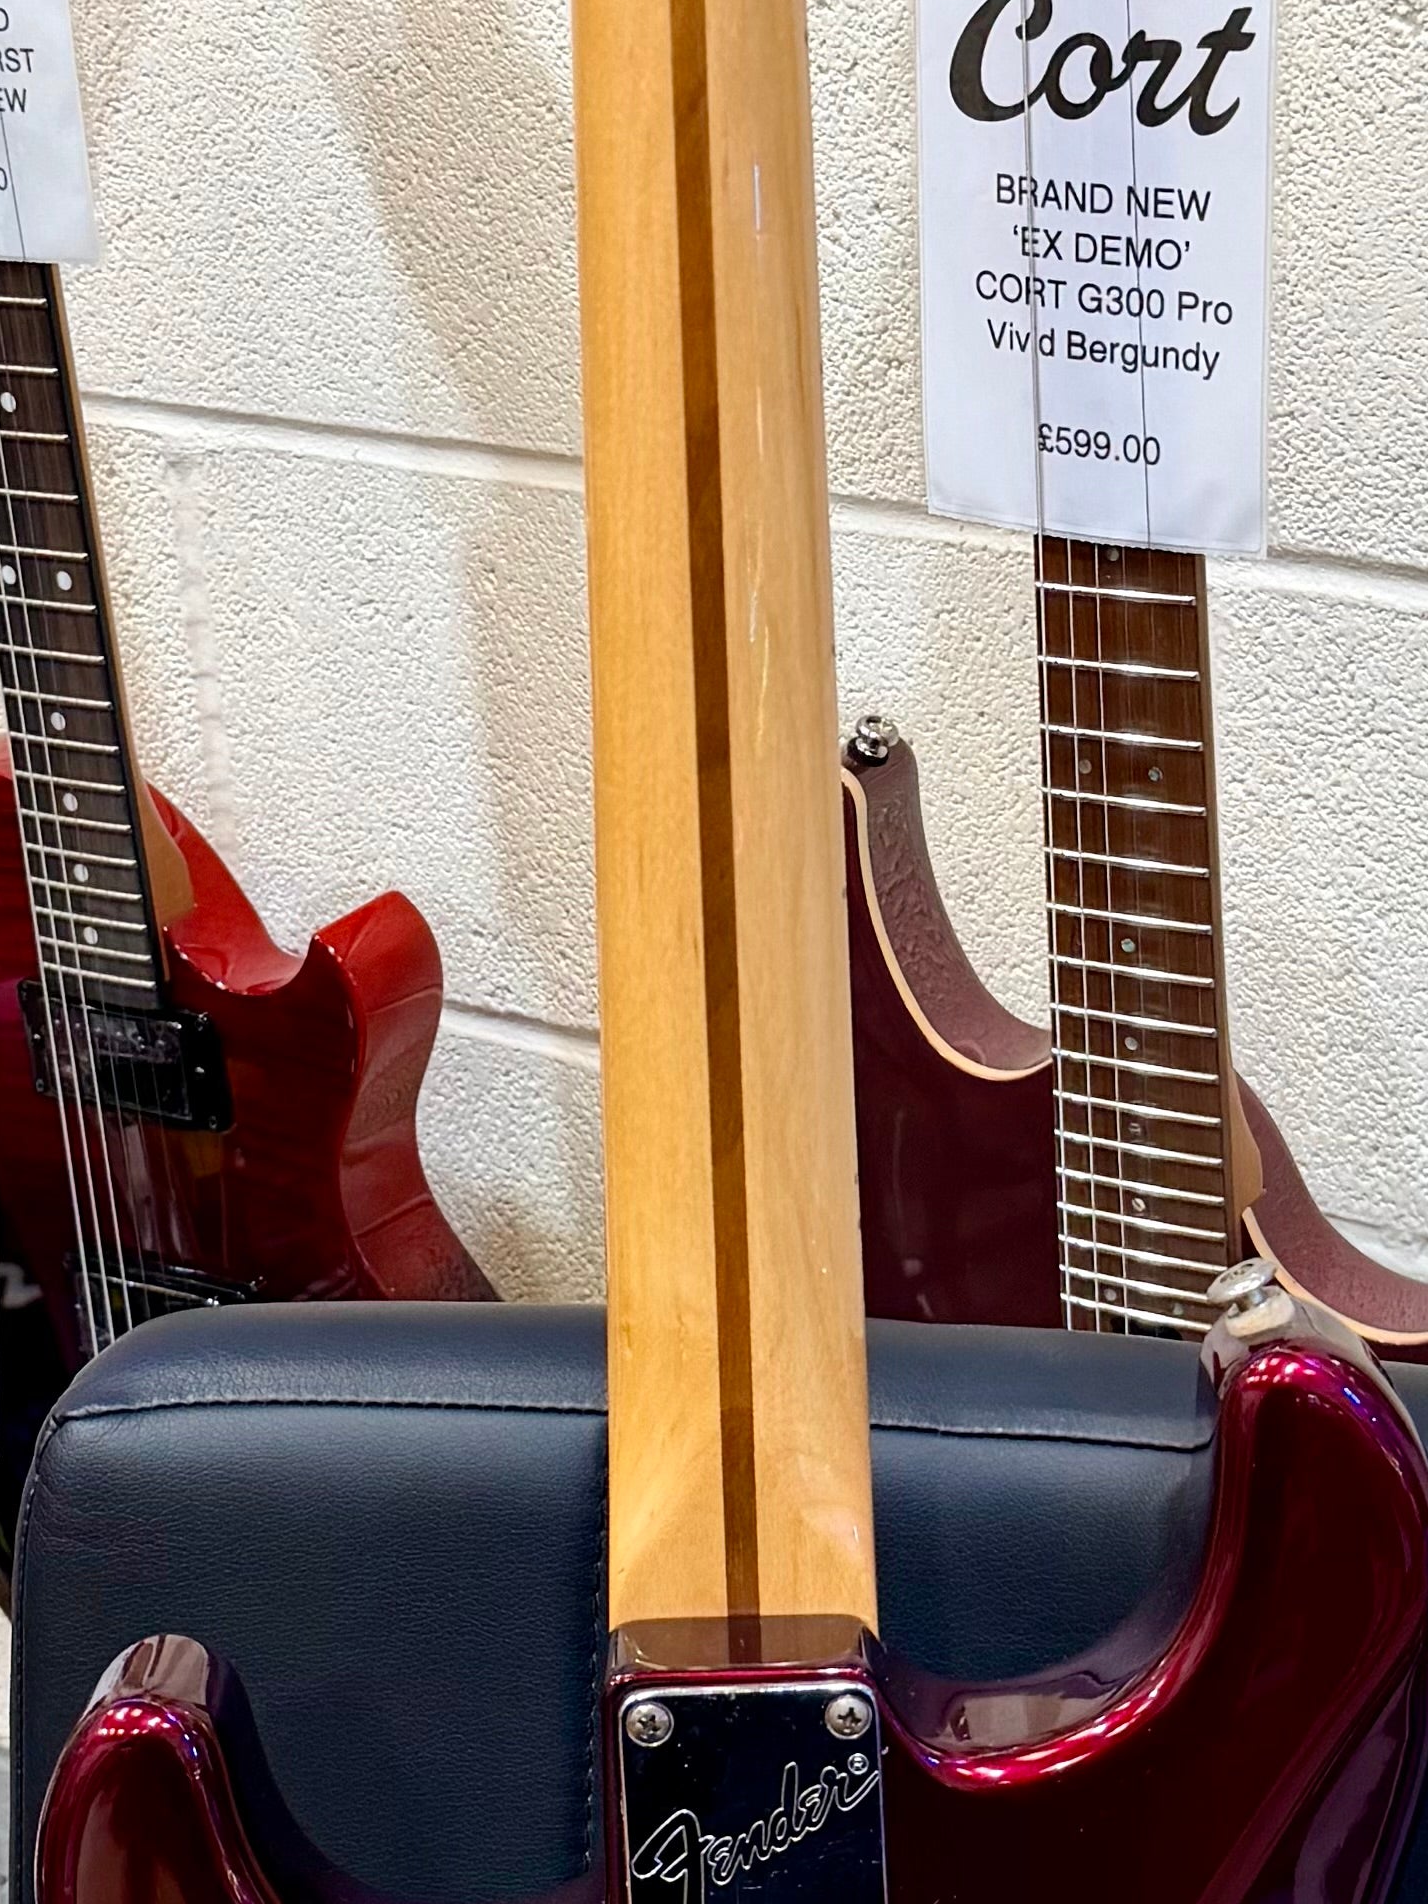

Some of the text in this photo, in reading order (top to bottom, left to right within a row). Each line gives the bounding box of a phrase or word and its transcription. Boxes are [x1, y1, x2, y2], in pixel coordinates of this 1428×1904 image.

[995, 173, 1212, 222] BRAND NEW
[975, 270, 1234, 326] CORT G300 Pro
[1066, 330, 1220, 381] Bergundy
[1037, 423, 1162, 466] £599.00
